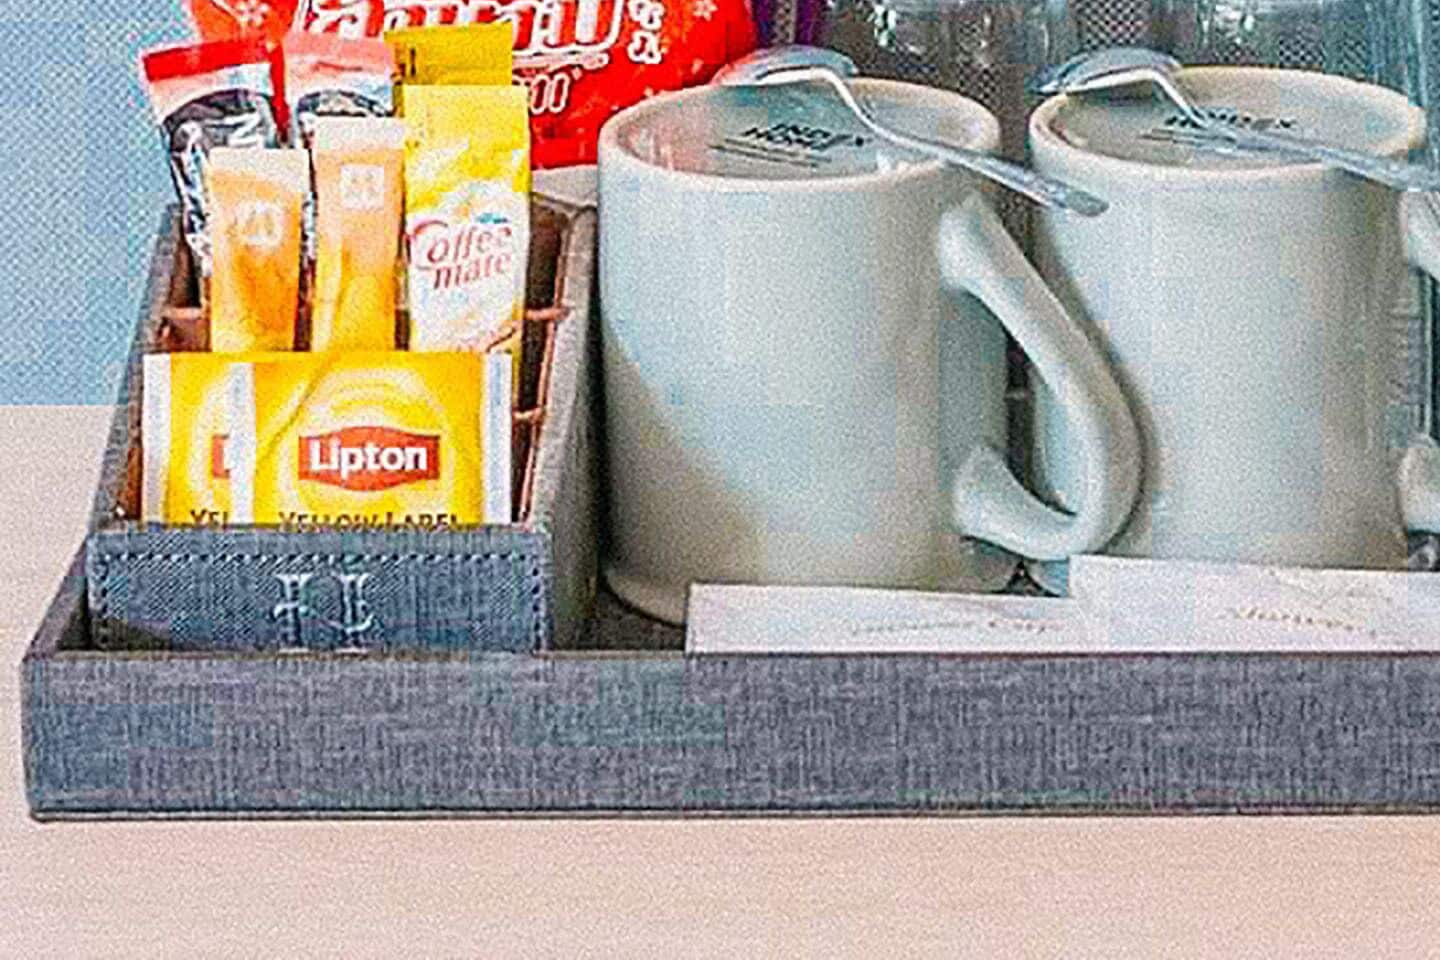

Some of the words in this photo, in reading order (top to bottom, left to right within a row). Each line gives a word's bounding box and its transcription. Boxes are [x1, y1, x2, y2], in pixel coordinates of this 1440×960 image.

[403, 220, 512, 271] Coffee
[433, 253, 512, 290] mate
[309, 440, 429, 480] Lipton
